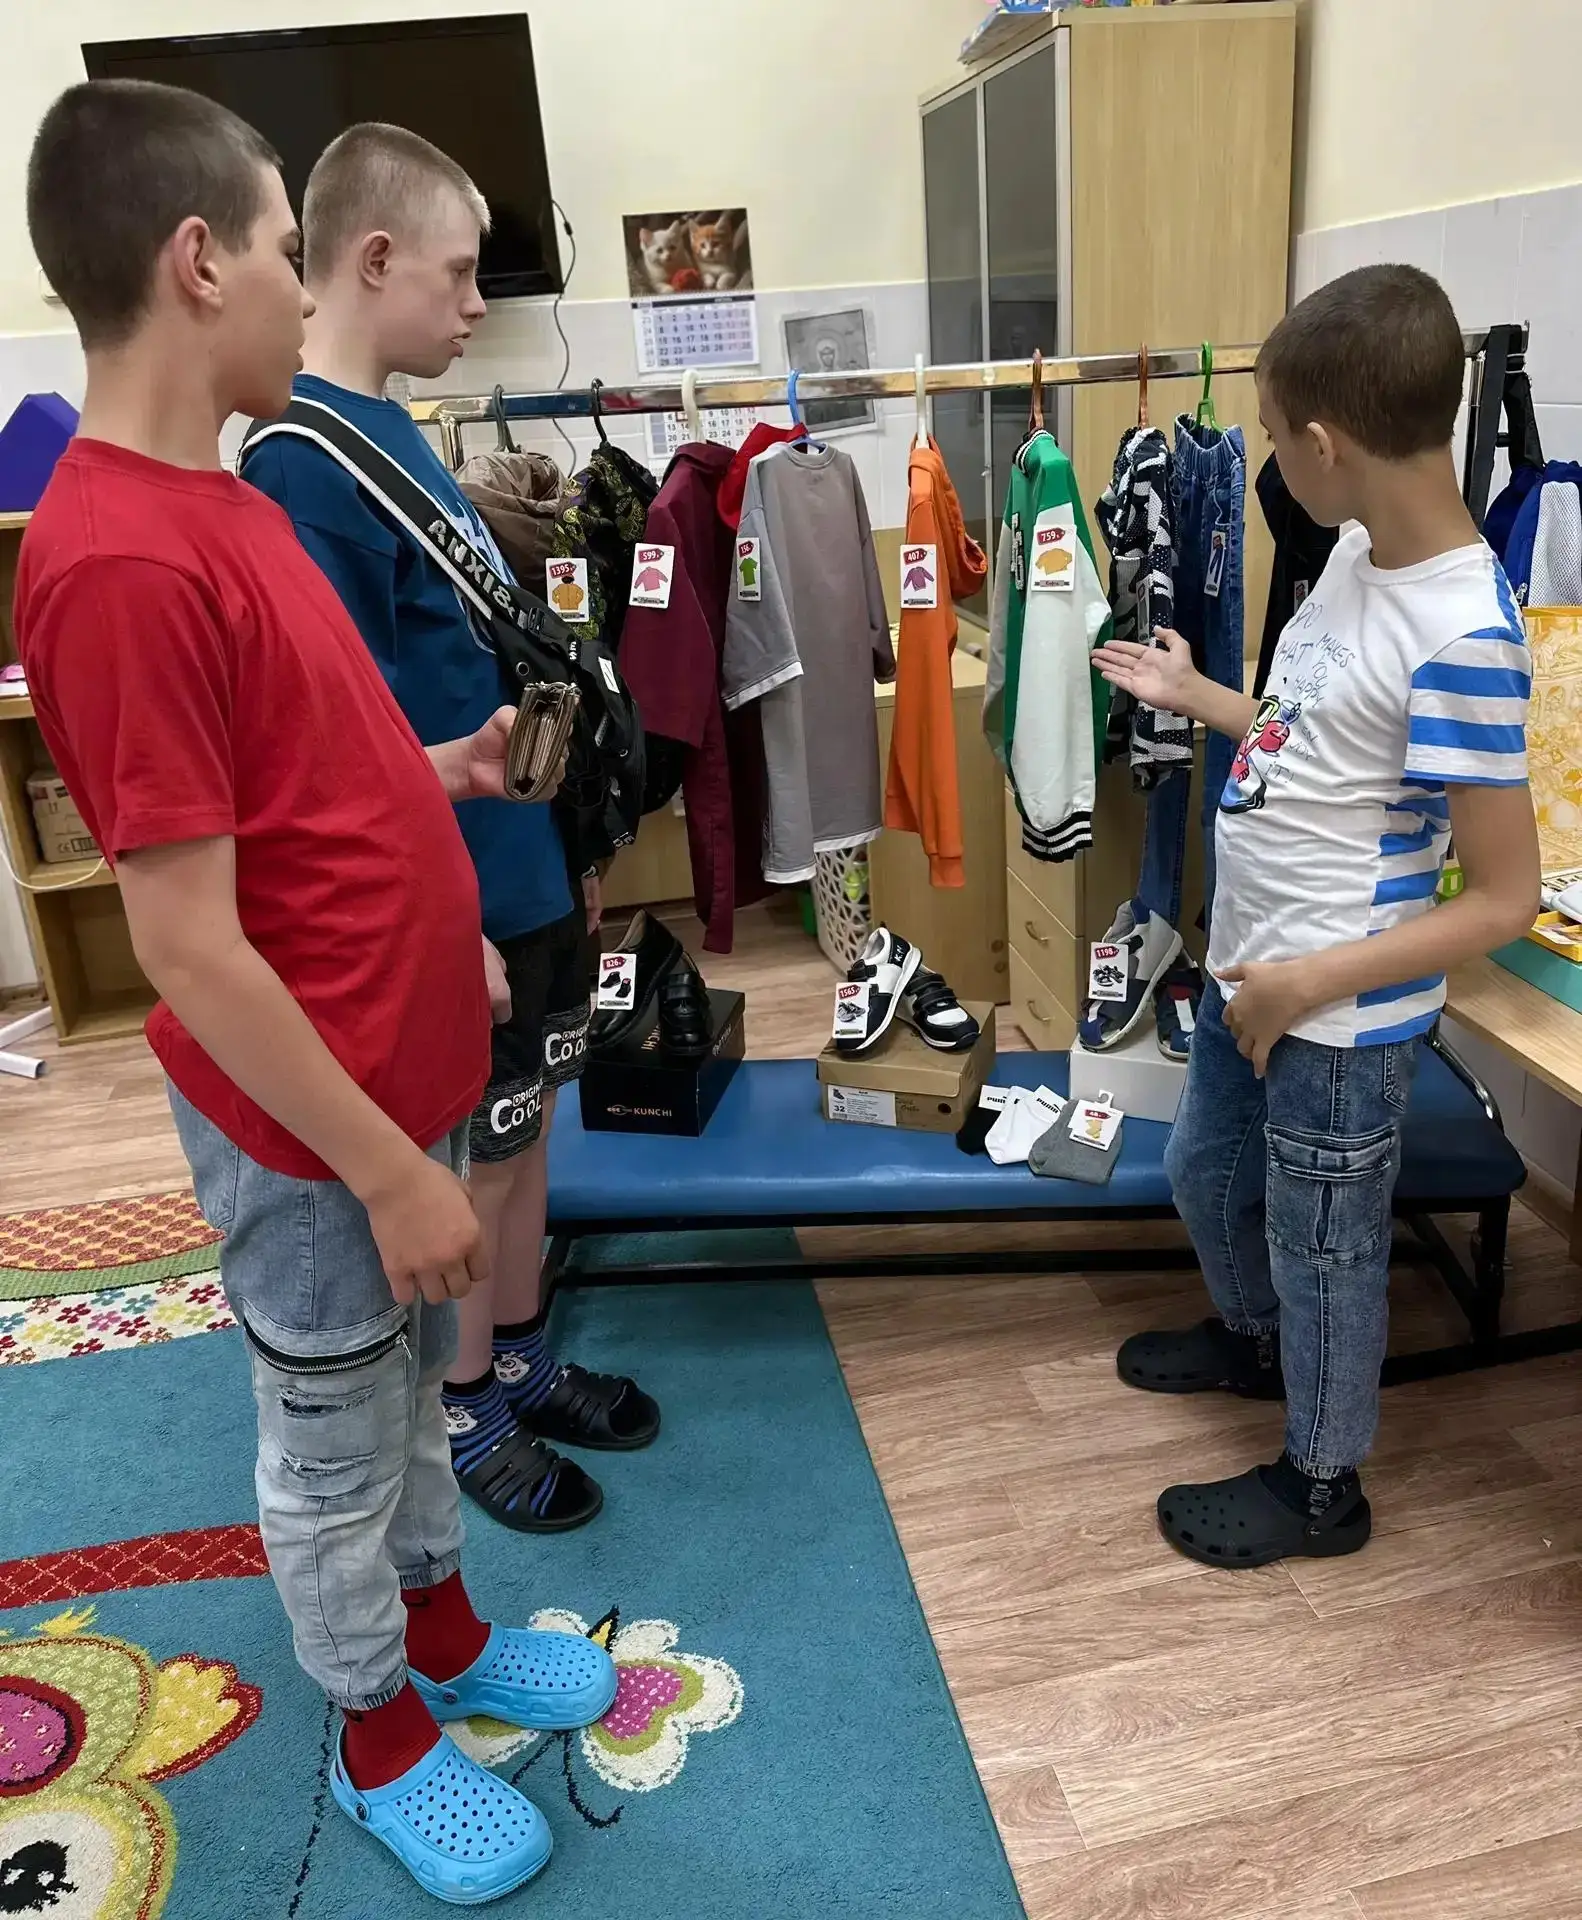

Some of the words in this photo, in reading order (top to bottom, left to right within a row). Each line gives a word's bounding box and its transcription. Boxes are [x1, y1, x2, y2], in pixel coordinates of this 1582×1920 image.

[1275, 640, 1314, 665] HAT
[1315, 631, 1356, 668] MAKES
[1294, 675, 1325, 709] HAPPY
[634, 1107, 672, 1117] KUNCHI
